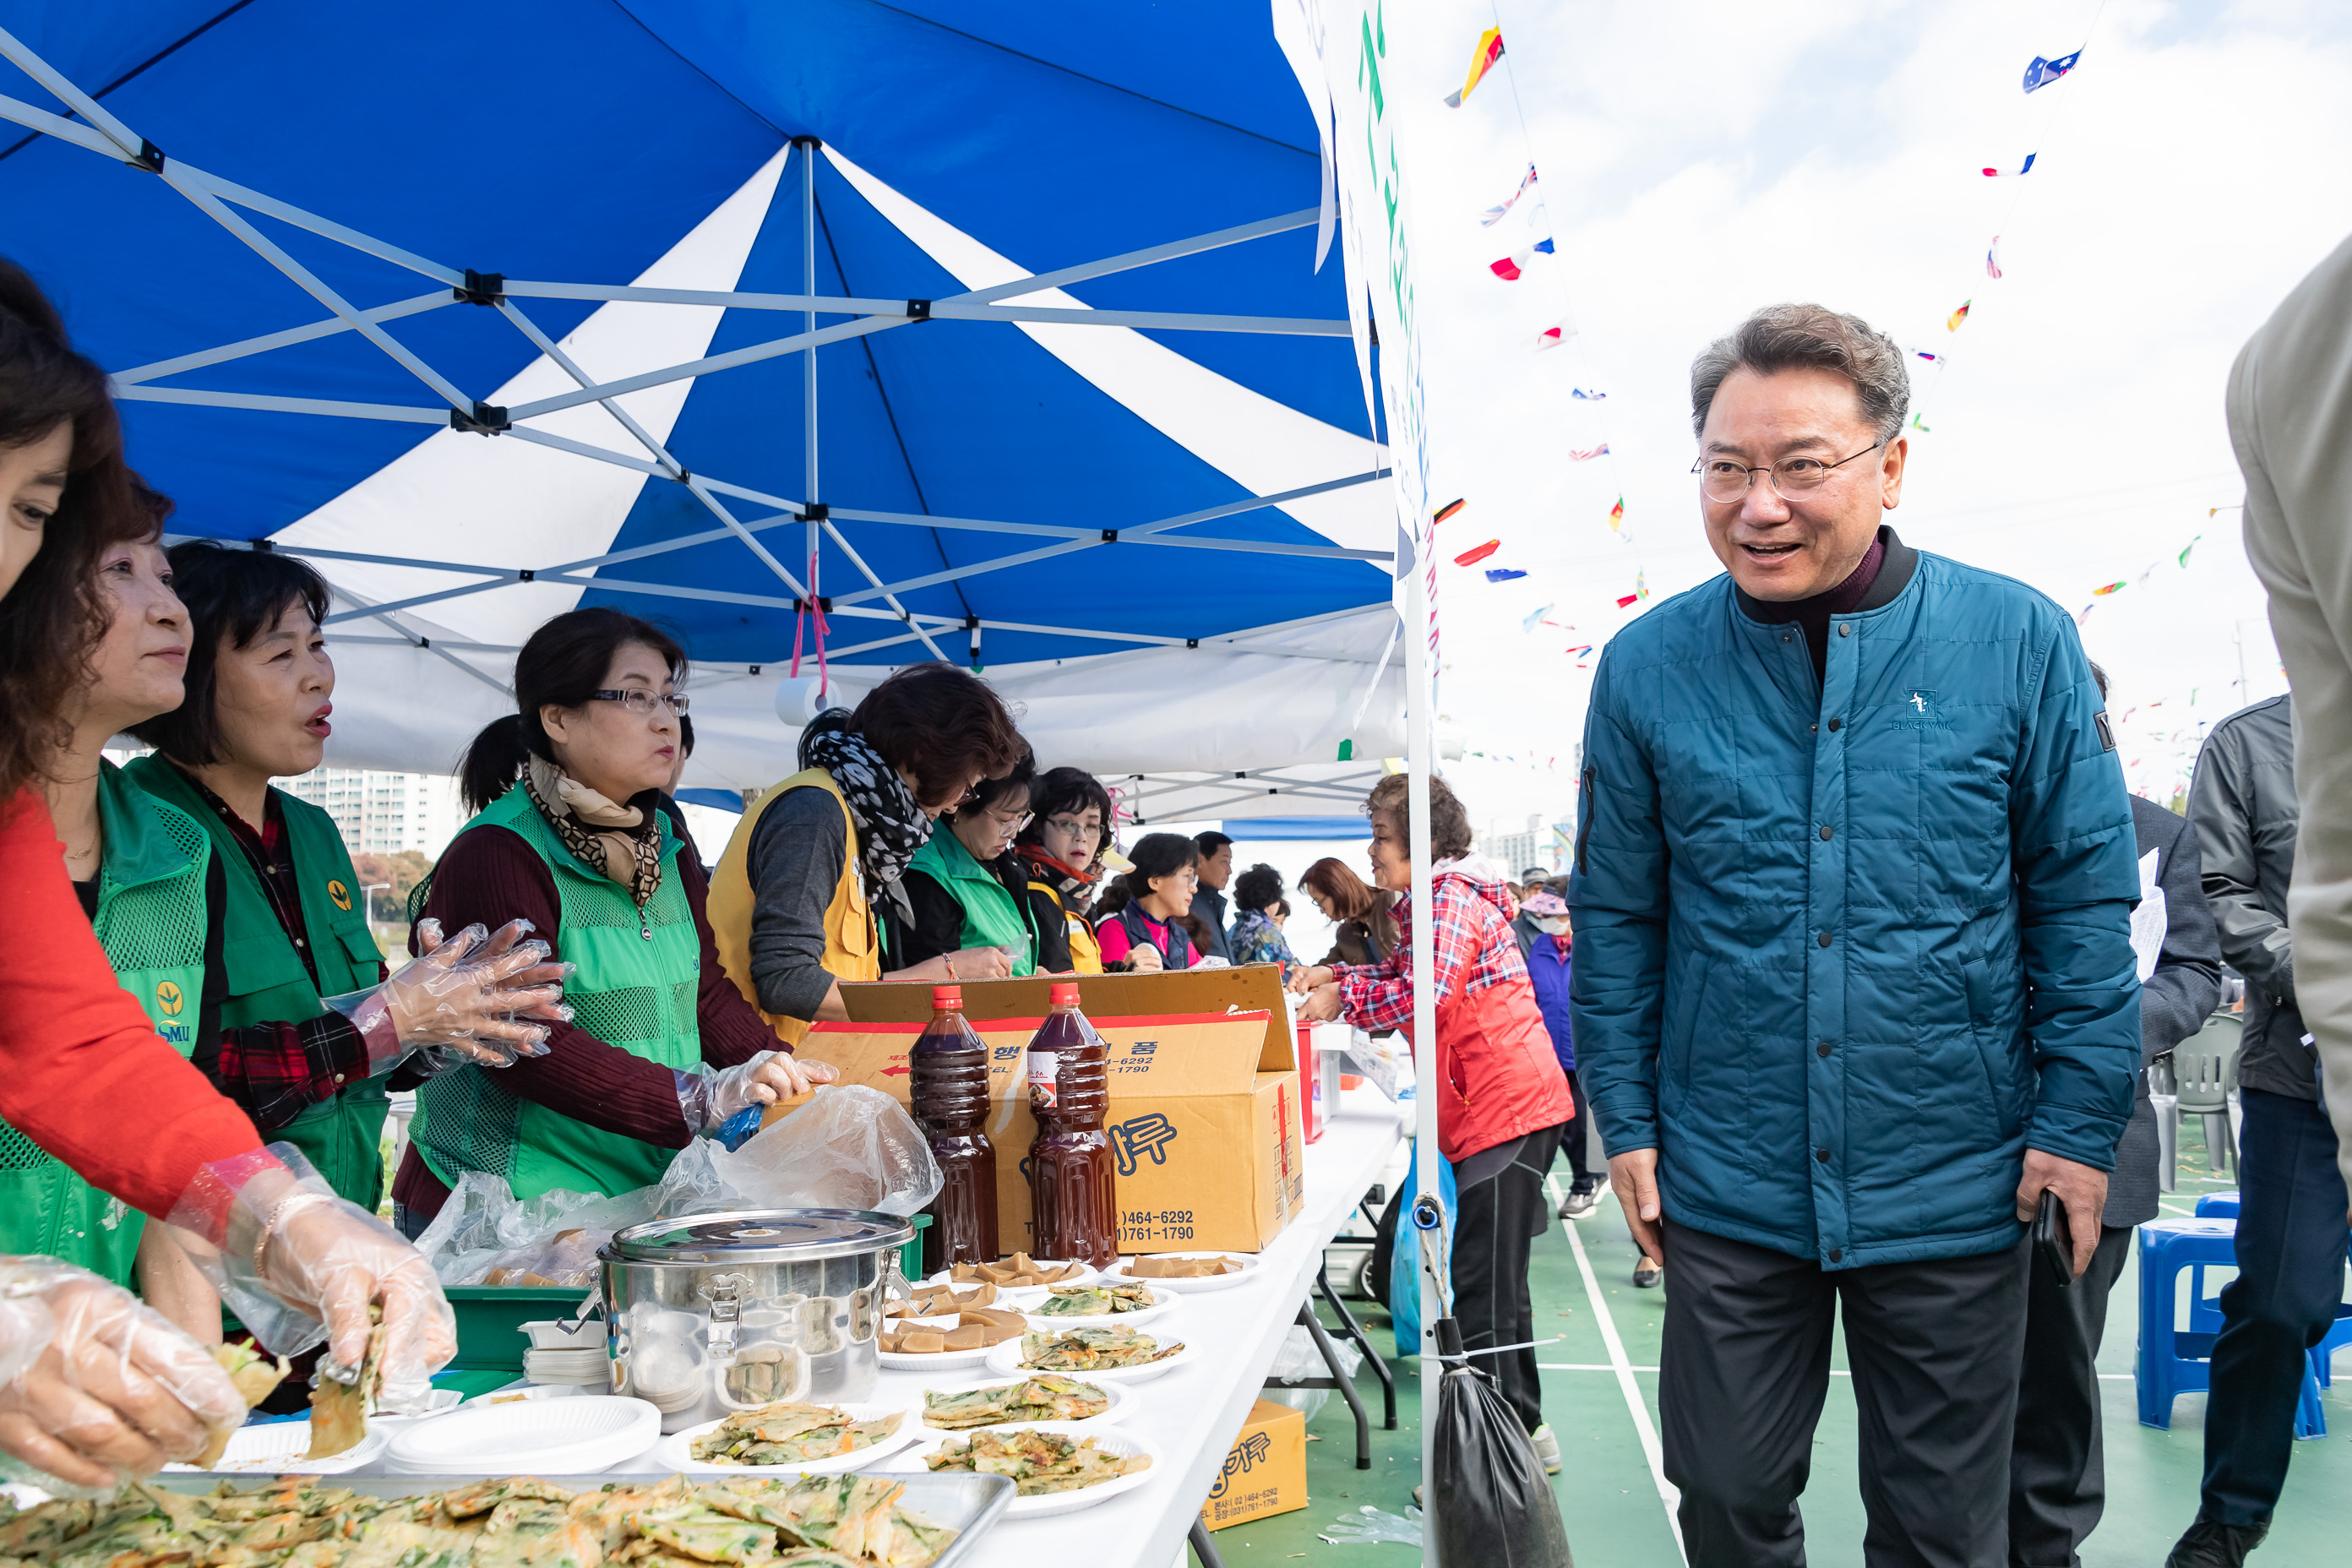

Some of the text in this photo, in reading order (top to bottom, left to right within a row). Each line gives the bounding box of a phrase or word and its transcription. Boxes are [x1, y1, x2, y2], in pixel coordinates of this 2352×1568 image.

[1892, 721, 1951, 731] BLACKYAK
[994, 1042, 1158, 1060] 행 품
